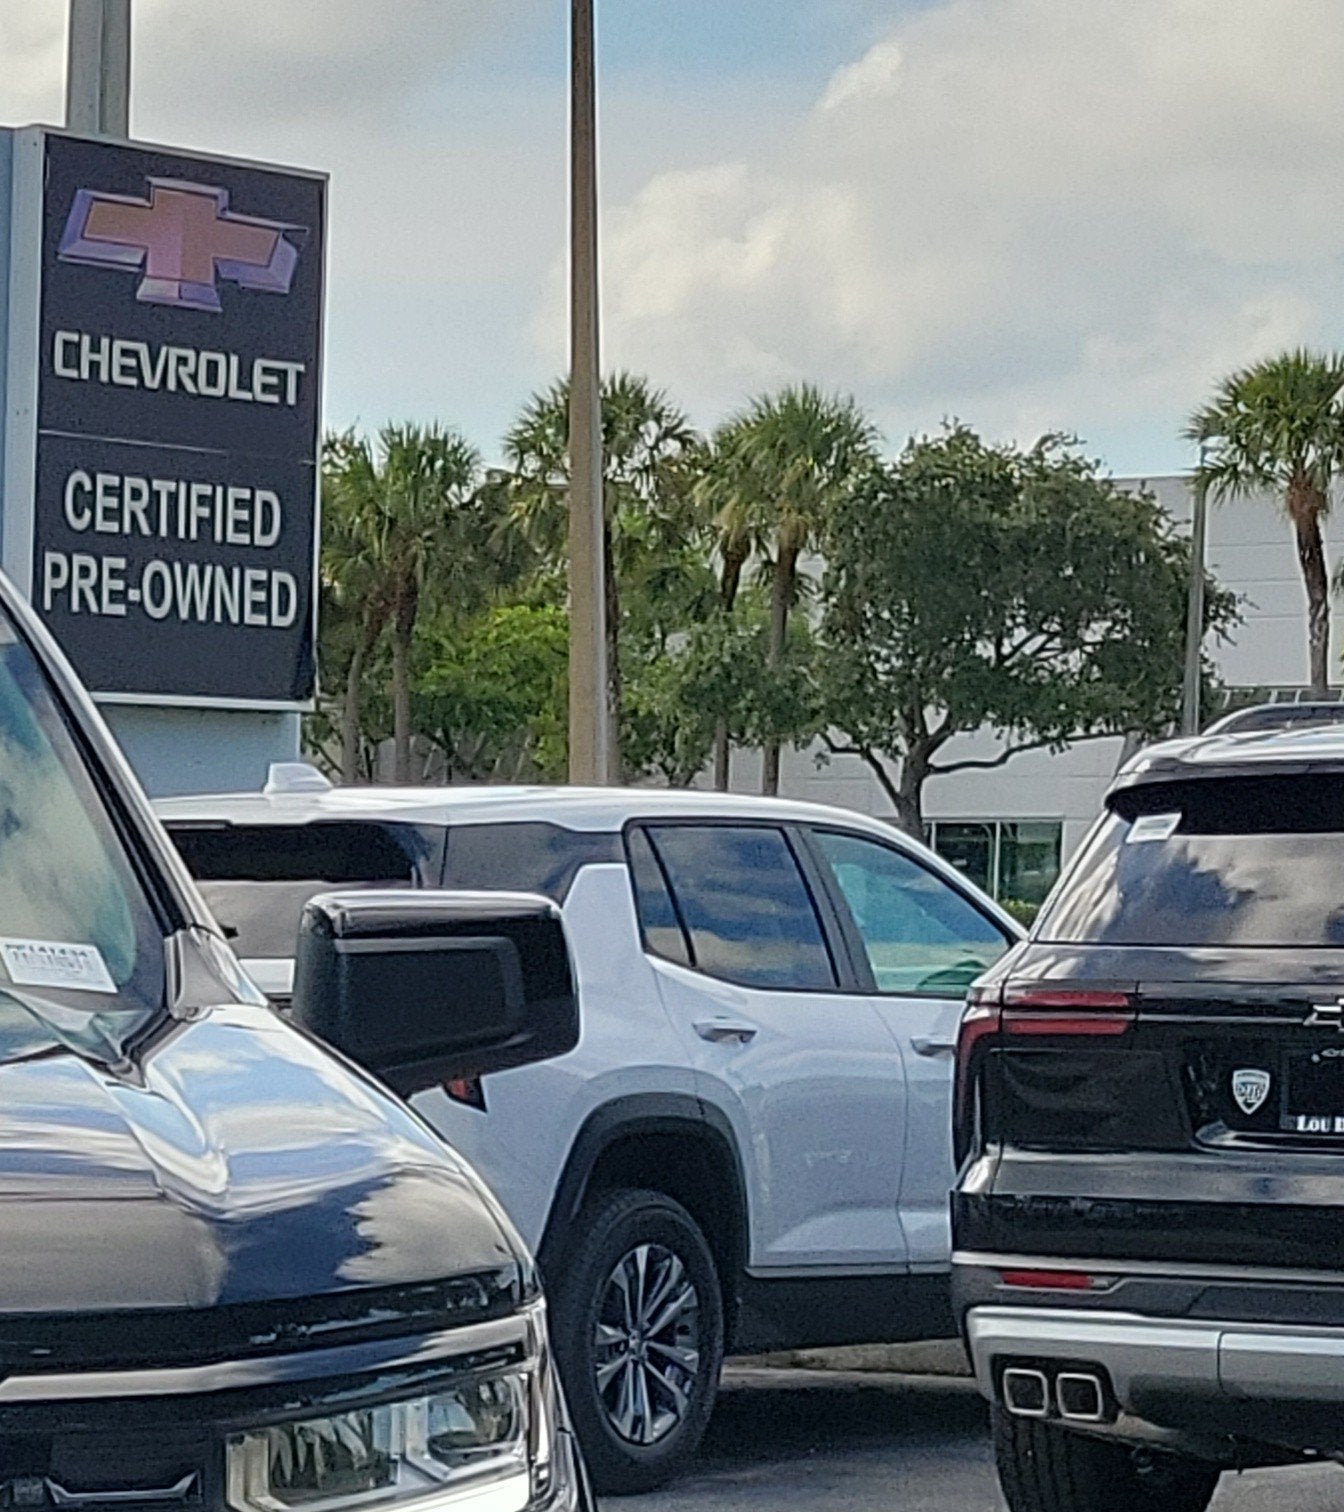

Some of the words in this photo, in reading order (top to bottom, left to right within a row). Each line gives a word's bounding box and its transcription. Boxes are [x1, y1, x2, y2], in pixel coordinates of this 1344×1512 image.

[53, 330, 305, 406] CHEVROLET
[64, 468, 282, 548] CERTIFIED
[43, 550, 298, 628] PRE-OWNED
